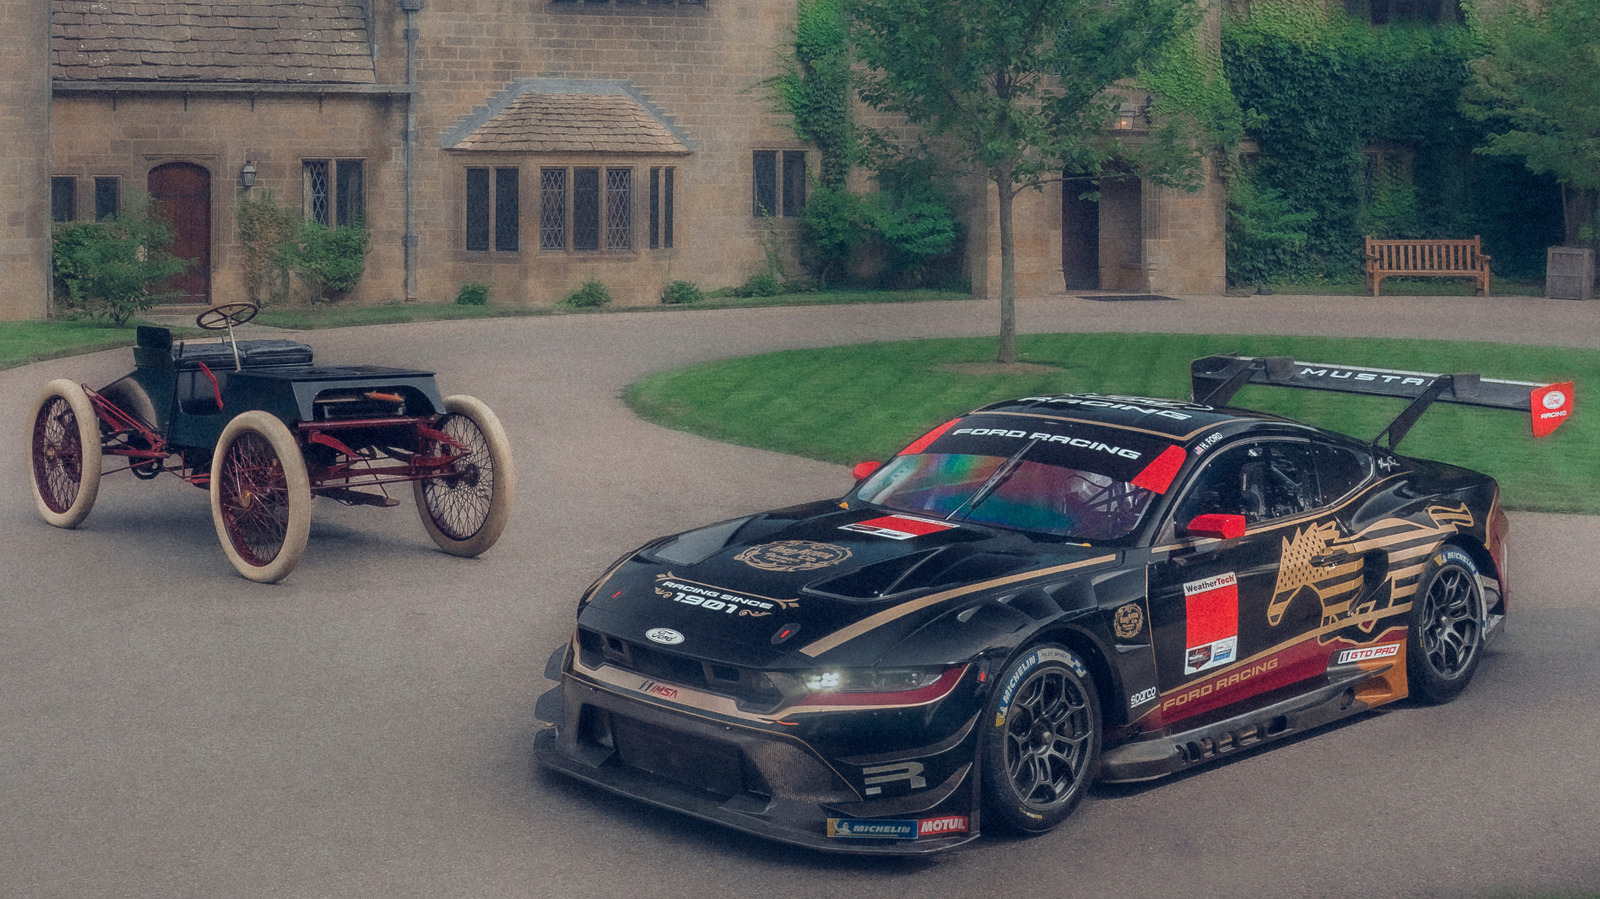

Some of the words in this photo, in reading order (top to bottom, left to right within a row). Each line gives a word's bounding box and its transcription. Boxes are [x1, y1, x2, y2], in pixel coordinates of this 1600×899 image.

[1018, 396, 1192, 420] RACING
[1541, 410, 1567, 419] RACING
[952, 428, 1027, 438] FORD
[1029, 432, 1142, 460] RACING
[1205, 432, 1223, 446] FORD
[1185, 575, 1234, 593] WeatherTech
[662, 581, 720, 598] RACING
[719, 594, 774, 610] SINCE
[673, 592, 738, 614] 1901
[651, 629, 677, 642] Ford
[1350, 649, 1373, 660] GTD
[1374, 646, 1397, 657] PRO
[1002, 655, 1037, 704] MICHELIN
[1163, 684, 1213, 712] FORD
[1216, 657, 1279, 691] RACING
[650, 684, 678, 699] IMSA
[1131, 686, 1157, 707] sparco
[852, 825, 911, 833] MICHELIN
[920, 818, 966, 833] MOTUL
